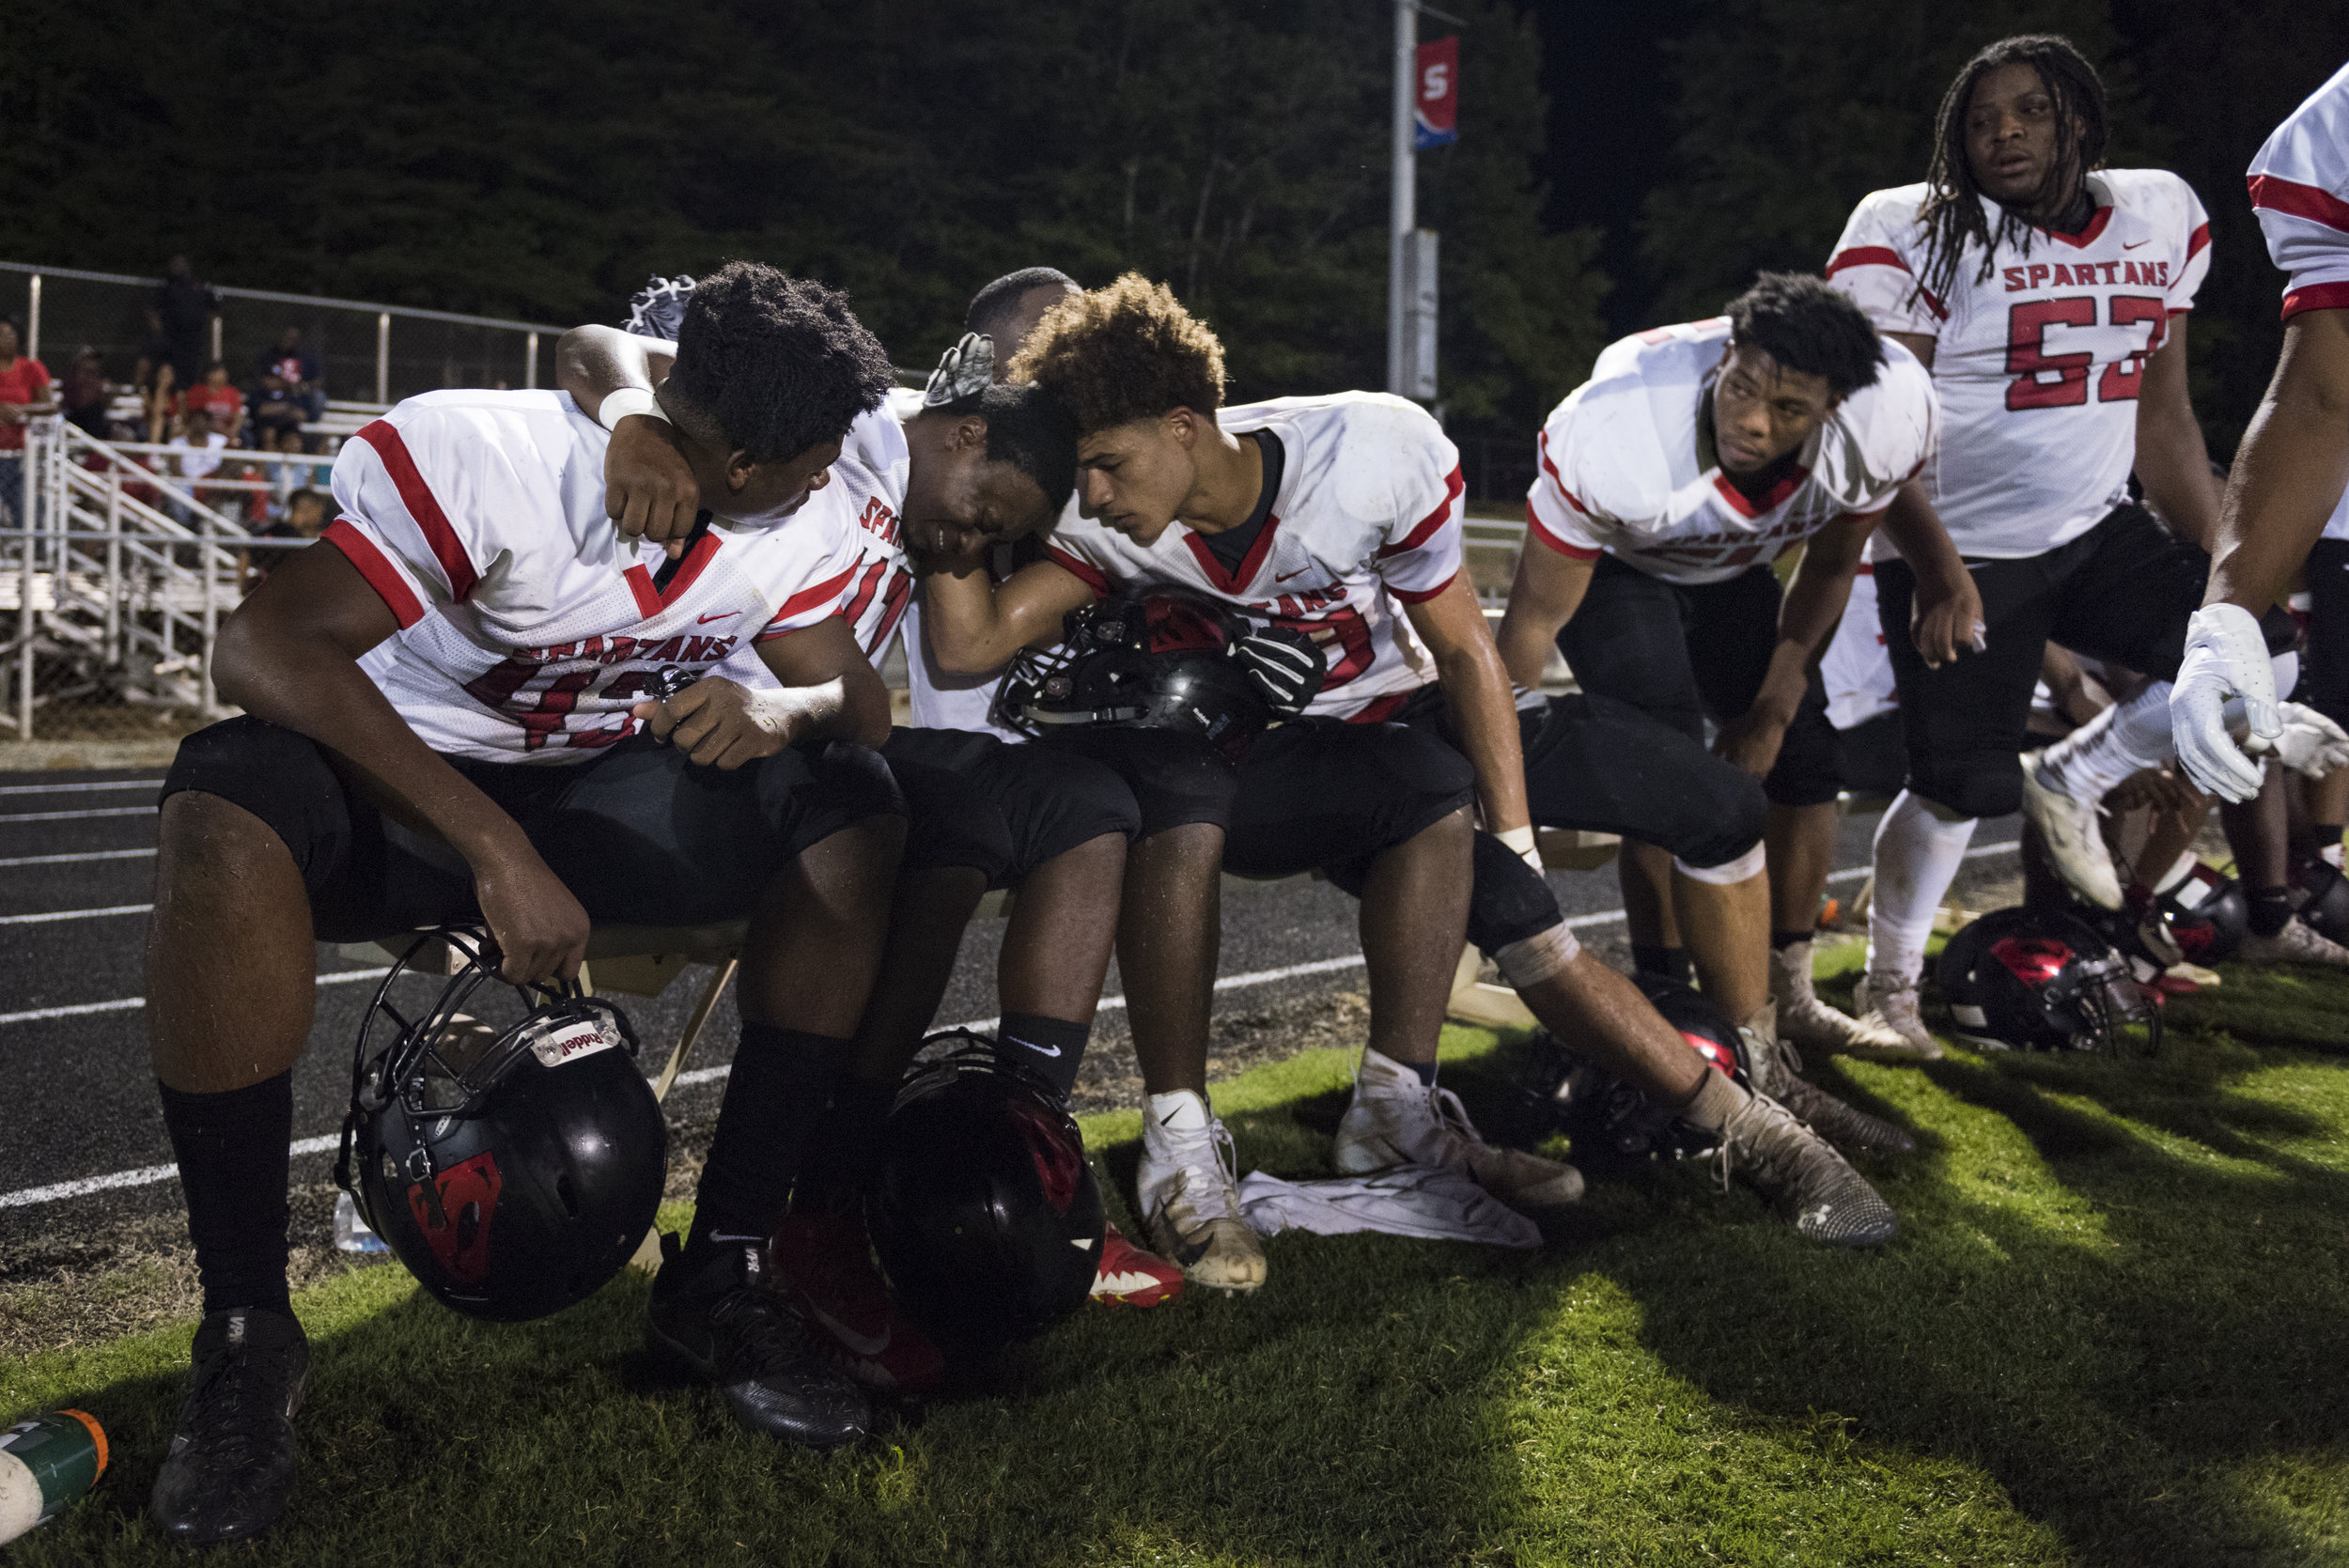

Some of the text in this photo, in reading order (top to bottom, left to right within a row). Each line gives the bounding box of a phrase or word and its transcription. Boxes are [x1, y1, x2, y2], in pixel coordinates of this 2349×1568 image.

[1423, 63, 1448, 101] S
[2002, 261, 2169, 292] SPARTANS
[2004, 294, 2166, 411] 62
